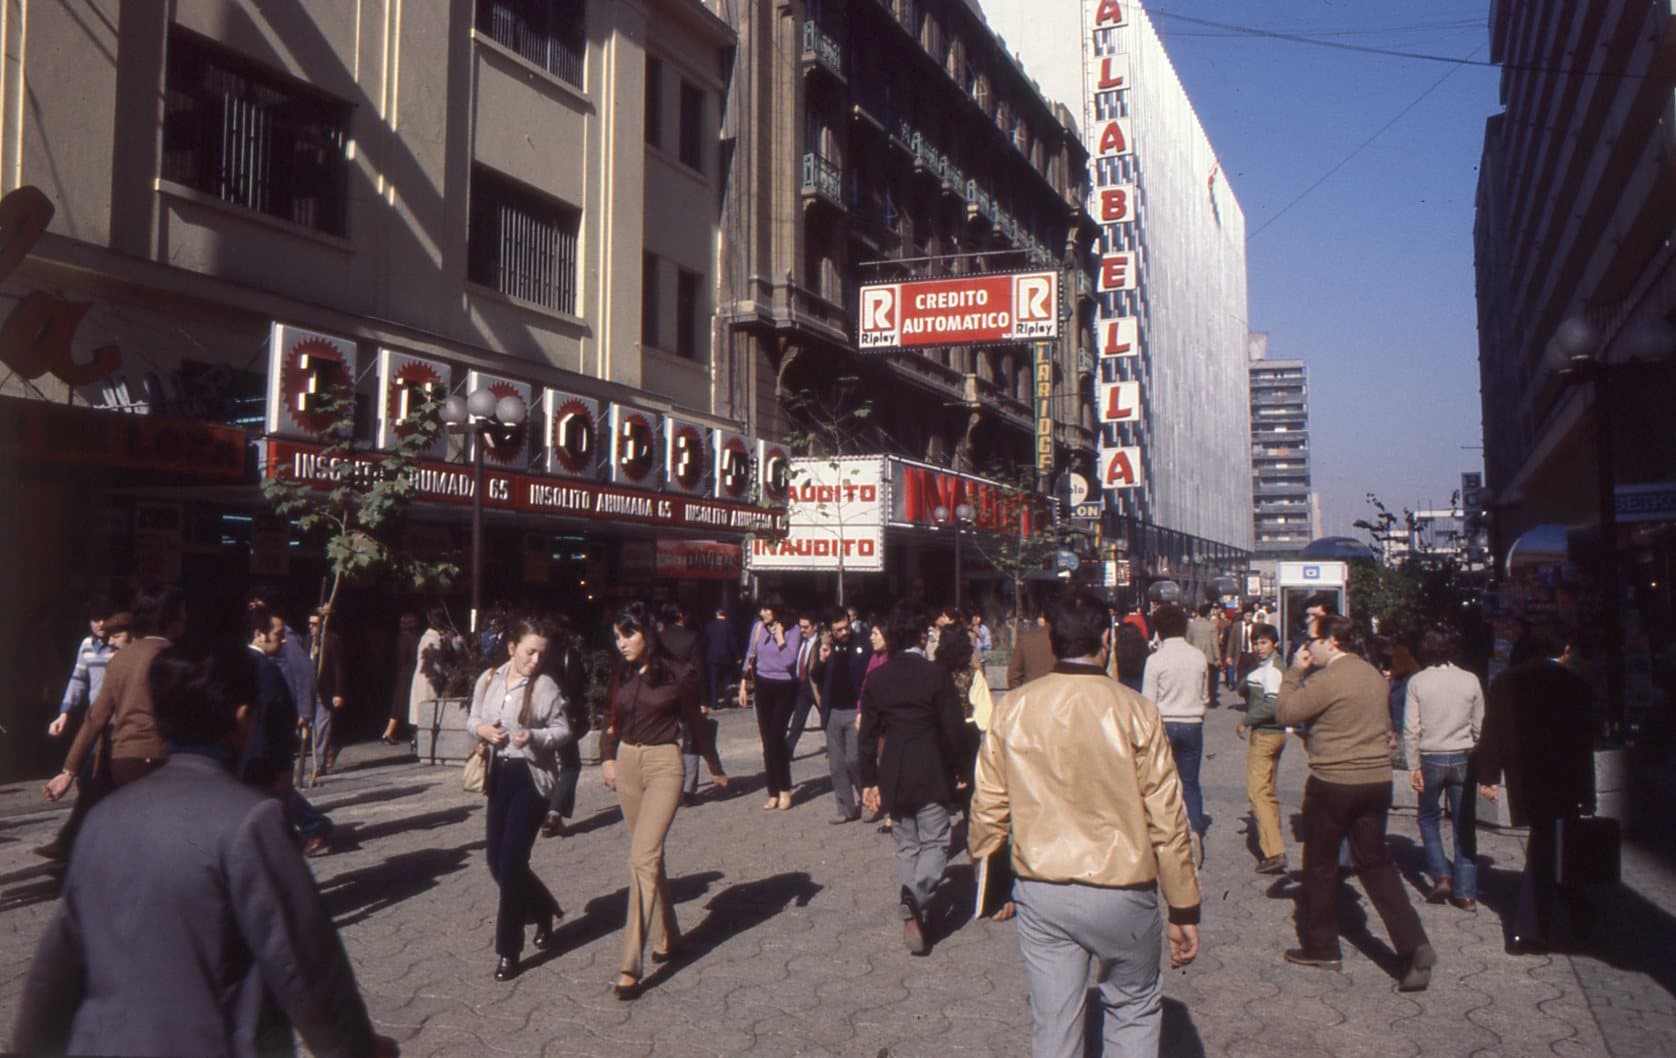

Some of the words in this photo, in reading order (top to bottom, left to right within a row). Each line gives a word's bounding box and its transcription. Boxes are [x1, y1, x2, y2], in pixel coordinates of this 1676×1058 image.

[915, 289, 988, 310] CREDITO
[1018, 277, 1050, 319] R
[864, 290, 892, 330] R
[902, 312, 1009, 335] AUTOMATICO
[1016, 322, 1053, 337] Ripley
[861, 332, 896, 346] Ripley
[489, 478, 509, 500] 65
[530, 483, 590, 510] INSOLITO
[596, 492, 653, 517] AHUMADA
[658, 500, 672, 518] 65
[754, 539, 875, 557] INAUDITO
